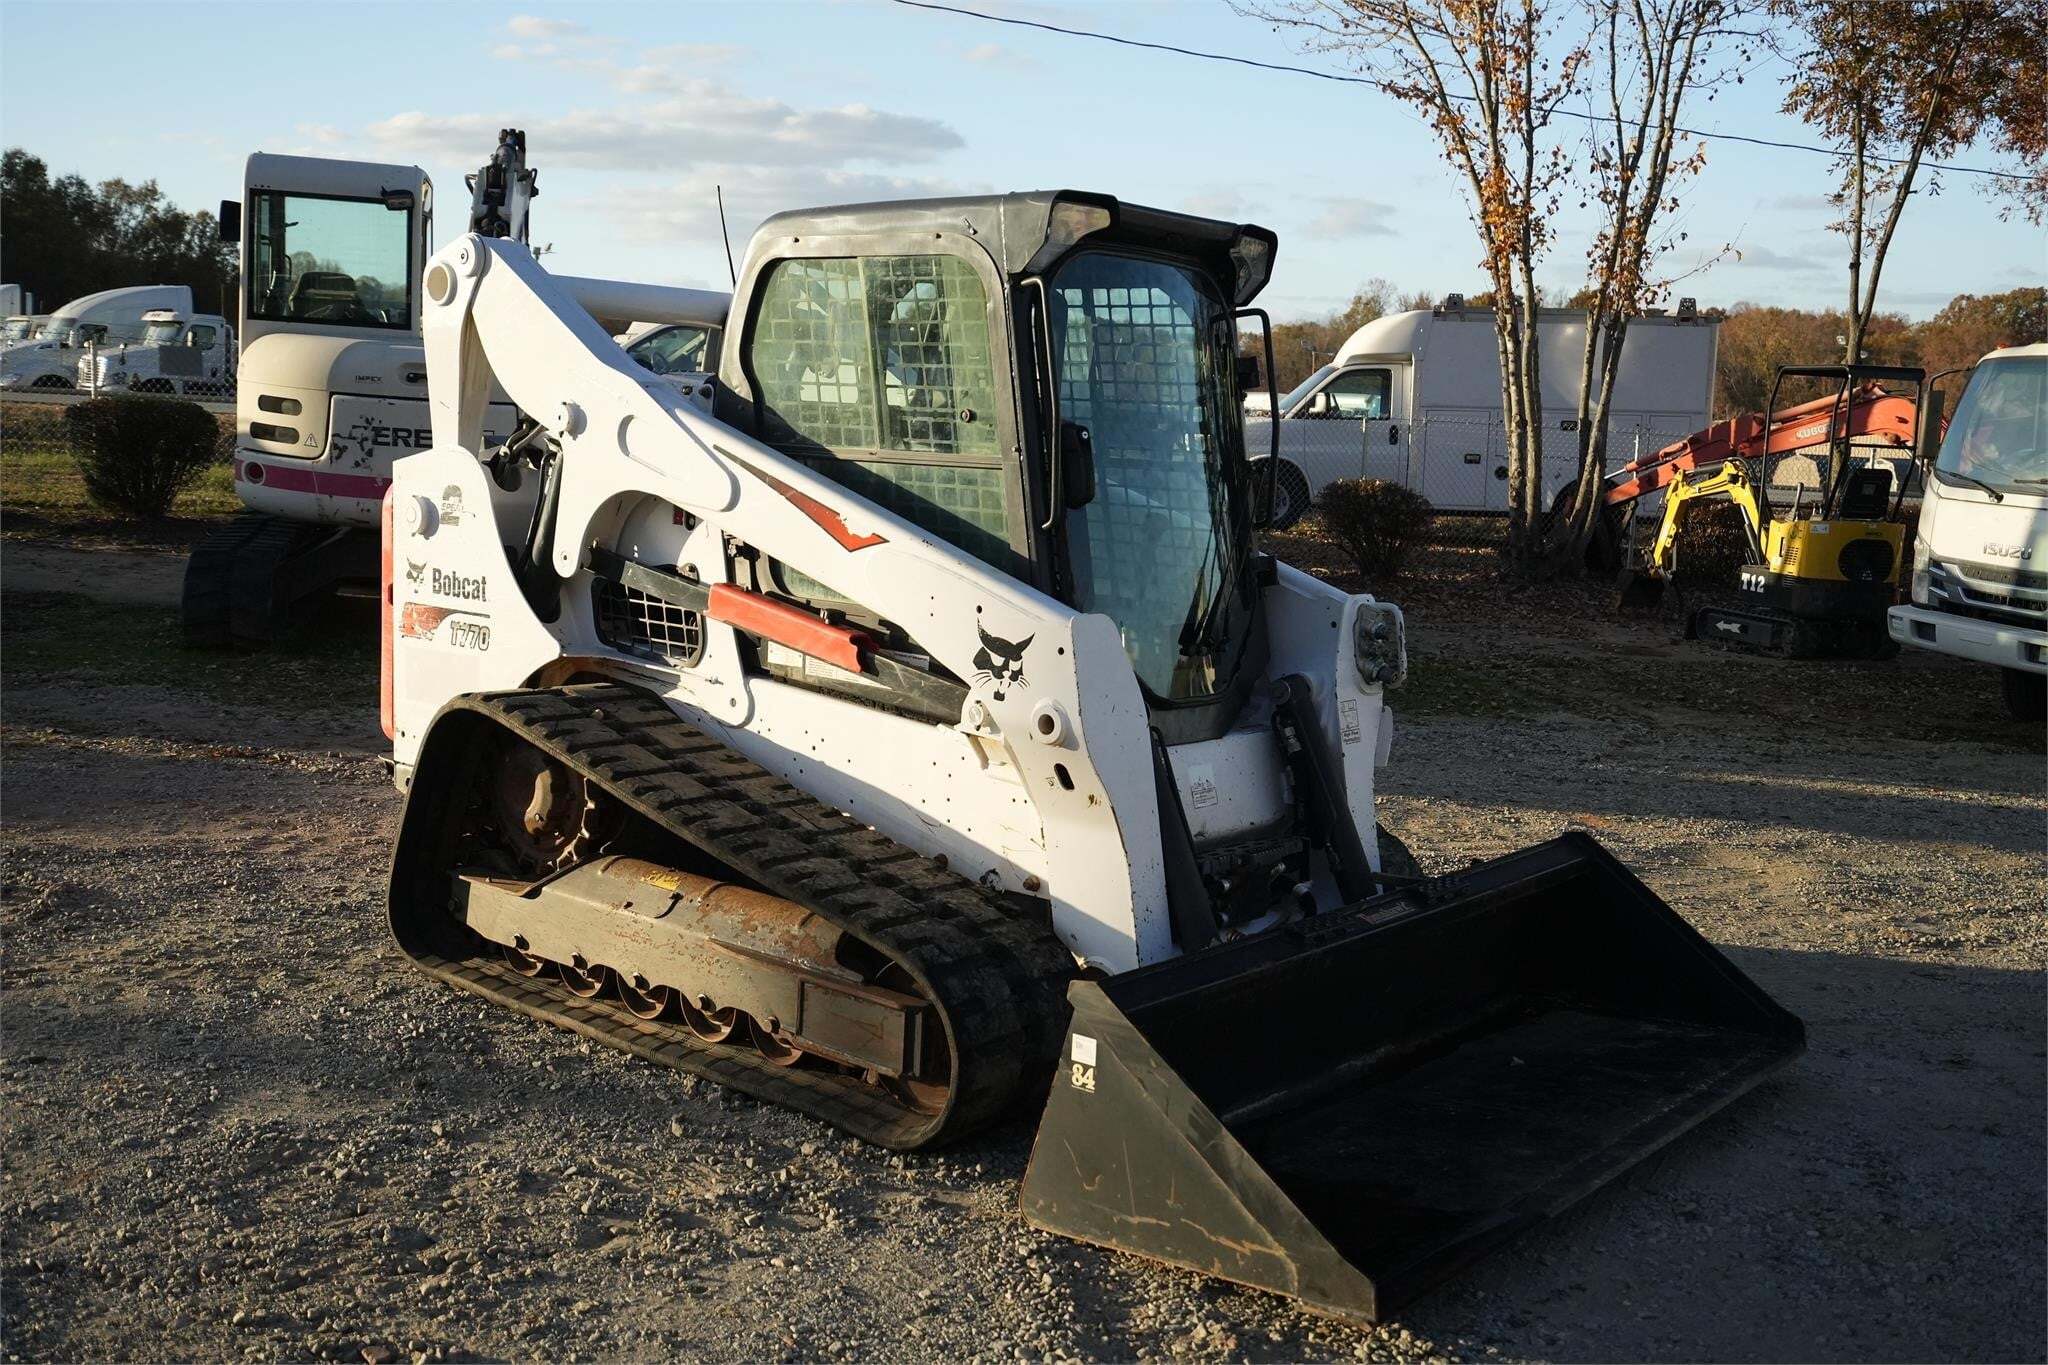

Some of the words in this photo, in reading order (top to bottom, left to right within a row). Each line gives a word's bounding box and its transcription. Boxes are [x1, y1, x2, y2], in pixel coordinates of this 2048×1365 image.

[1984, 543, 2032, 560] ISUZU
[432, 567, 487, 602] Bobcat
[1741, 572, 1765, 593] T12
[450, 620, 490, 652] T770
[1071, 1063, 1095, 1091] 84
